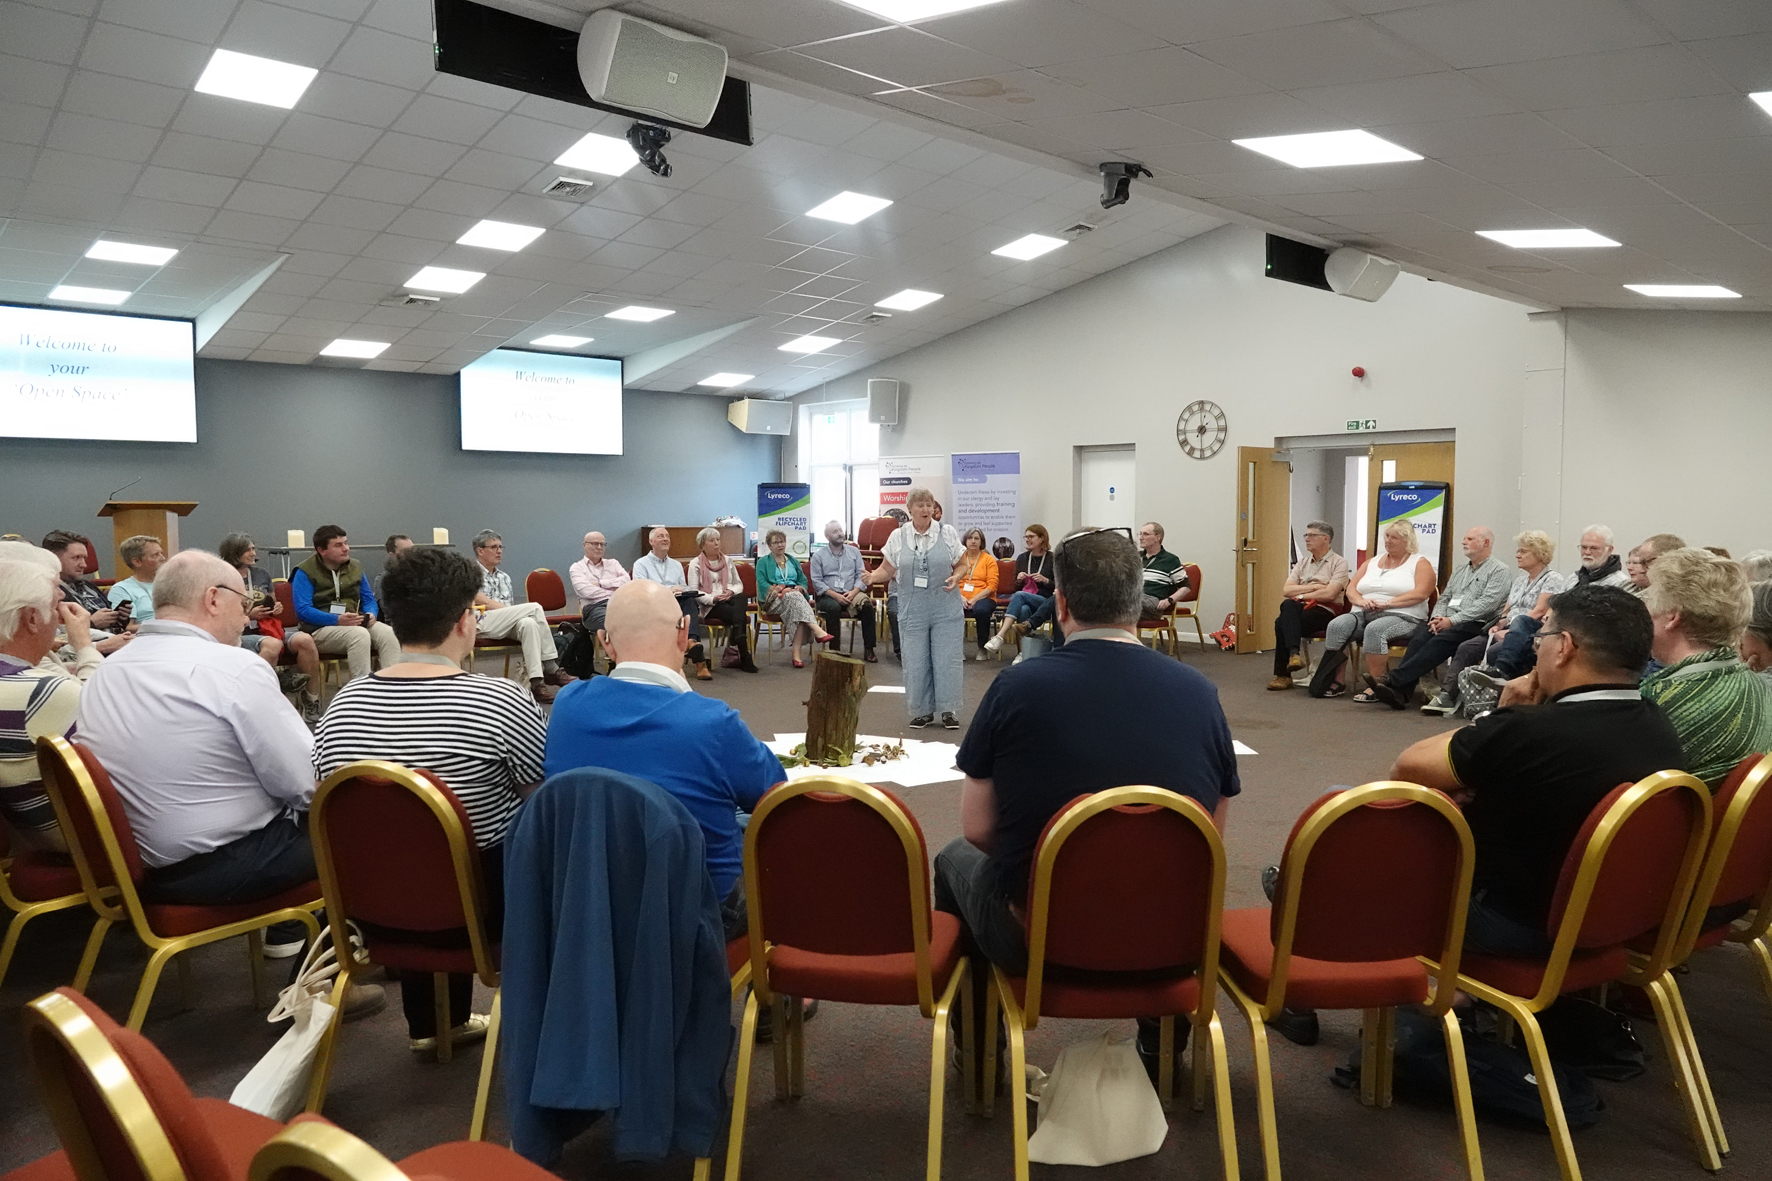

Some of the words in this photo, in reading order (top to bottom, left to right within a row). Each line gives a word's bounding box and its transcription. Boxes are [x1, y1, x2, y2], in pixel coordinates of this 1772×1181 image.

[20, 333, 96, 351] Welcome
[101, 343, 117, 353] to
[48, 363, 89, 377] your
[516, 370, 562, 384] Welcome
[565, 377, 575, 385] to
[883, 493, 907, 502] Worshi
[1391, 493, 1417, 501] Lyreco
